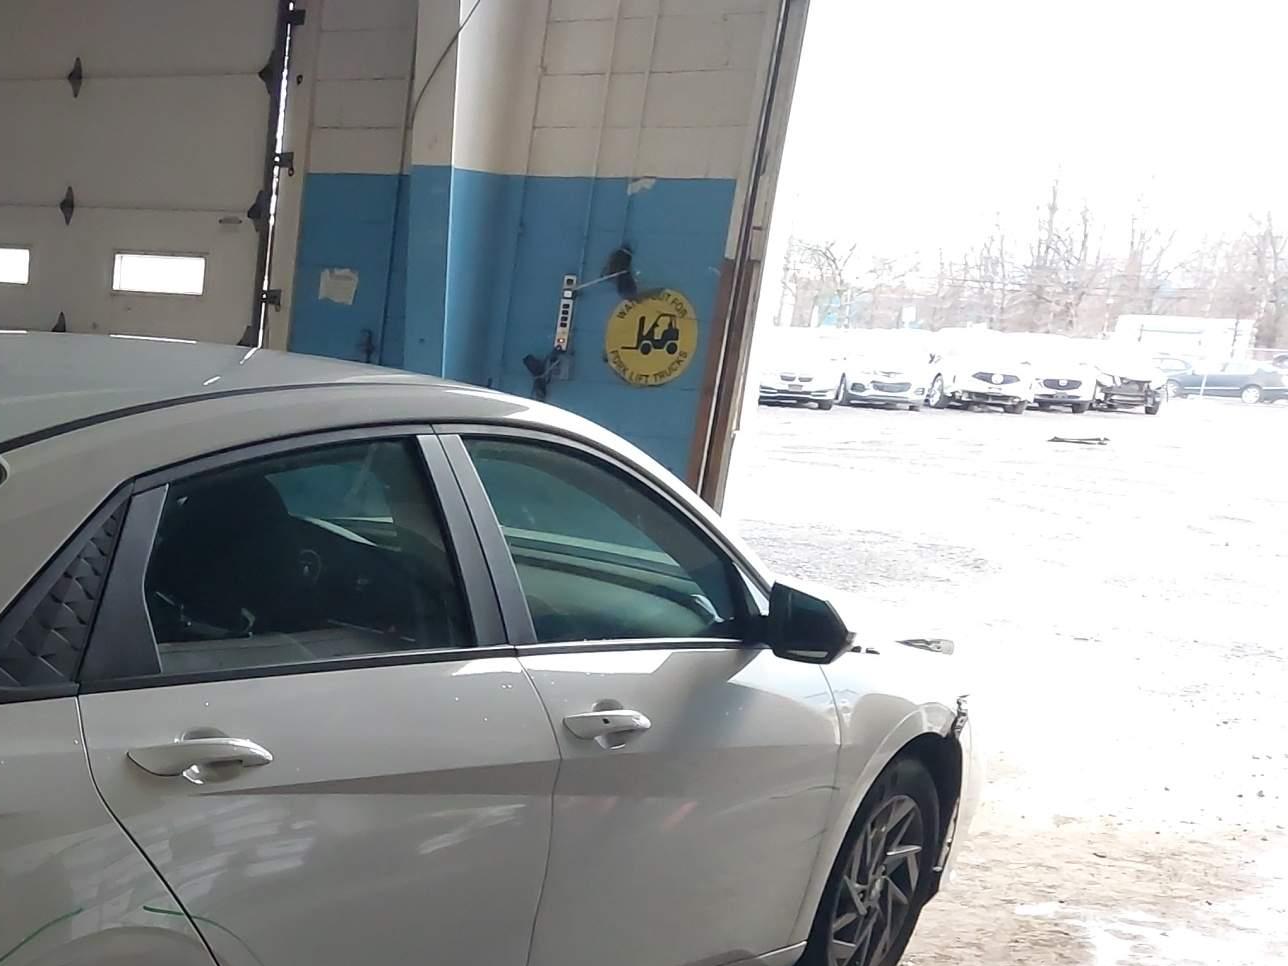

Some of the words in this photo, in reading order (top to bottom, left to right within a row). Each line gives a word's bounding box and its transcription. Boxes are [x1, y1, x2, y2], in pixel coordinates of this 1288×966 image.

[671, 299, 689, 318] FOR
[610, 350, 629, 376] FORK
[630, 372, 650, 384] LIFT
[653, 351, 689, 383] TRUCKS
